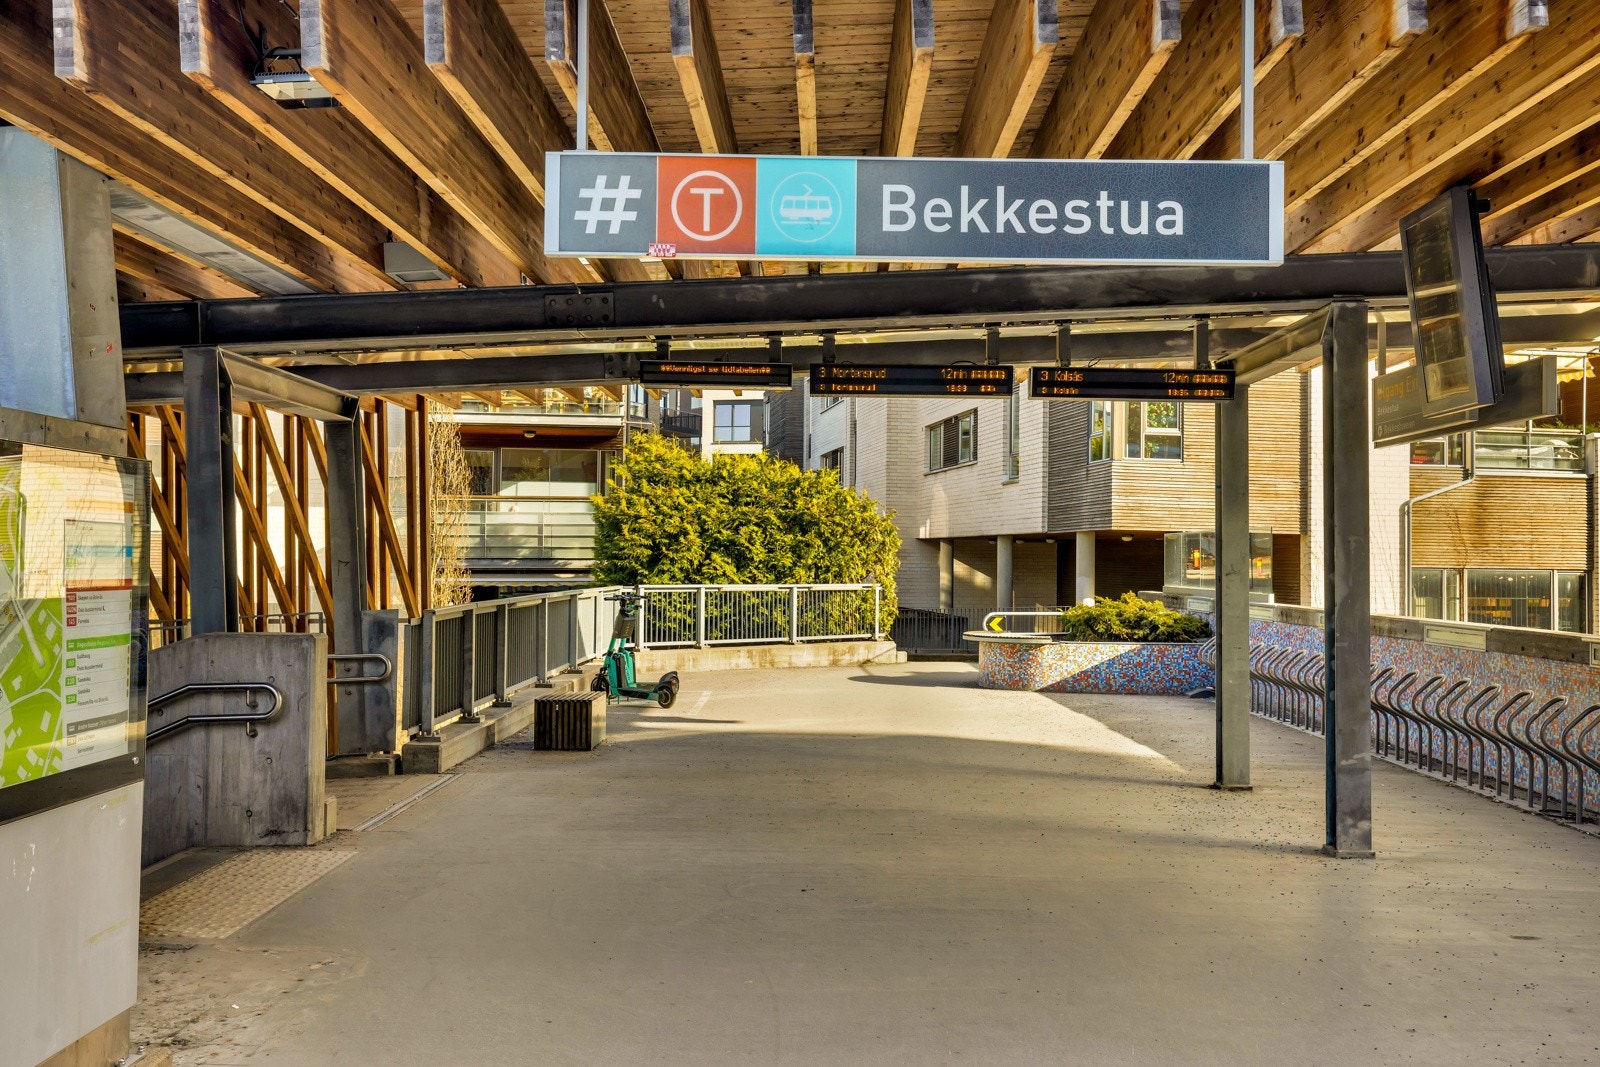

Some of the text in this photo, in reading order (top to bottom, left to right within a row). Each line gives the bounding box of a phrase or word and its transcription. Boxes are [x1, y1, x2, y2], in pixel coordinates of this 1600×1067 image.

[881, 183, 1185, 237] Bekkestua
[818, 366, 826, 378] 3
[1040, 370, 1049, 382] 3
[1054, 370, 1084, 382] Kolsås
